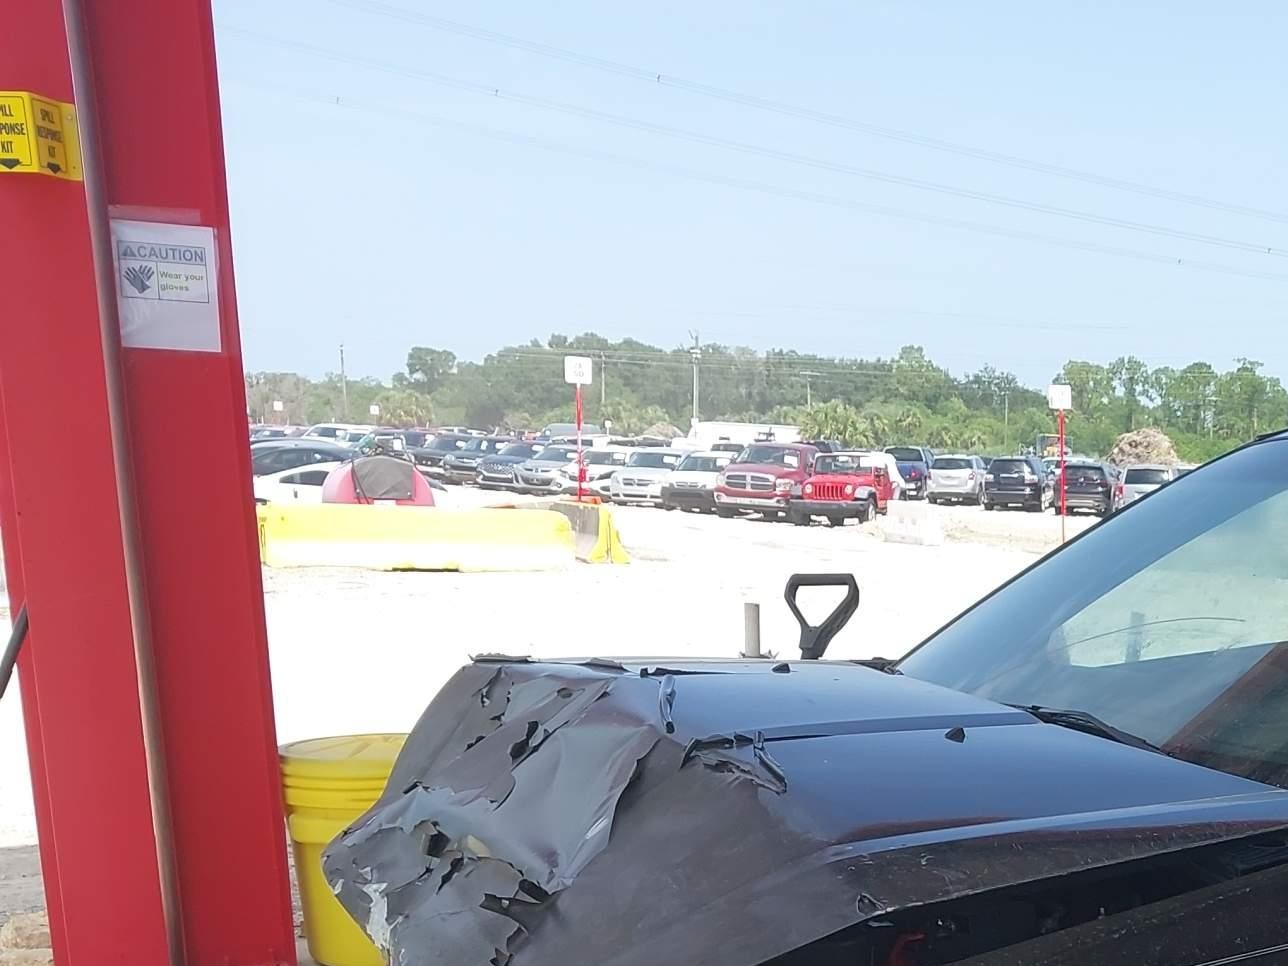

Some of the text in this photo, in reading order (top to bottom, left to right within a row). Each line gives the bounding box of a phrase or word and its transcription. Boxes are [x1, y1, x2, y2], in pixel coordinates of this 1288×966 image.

[1, 141, 13, 153] KIT
[137, 245, 204, 262] CAUTION
[159, 271, 204, 282] Wear your
